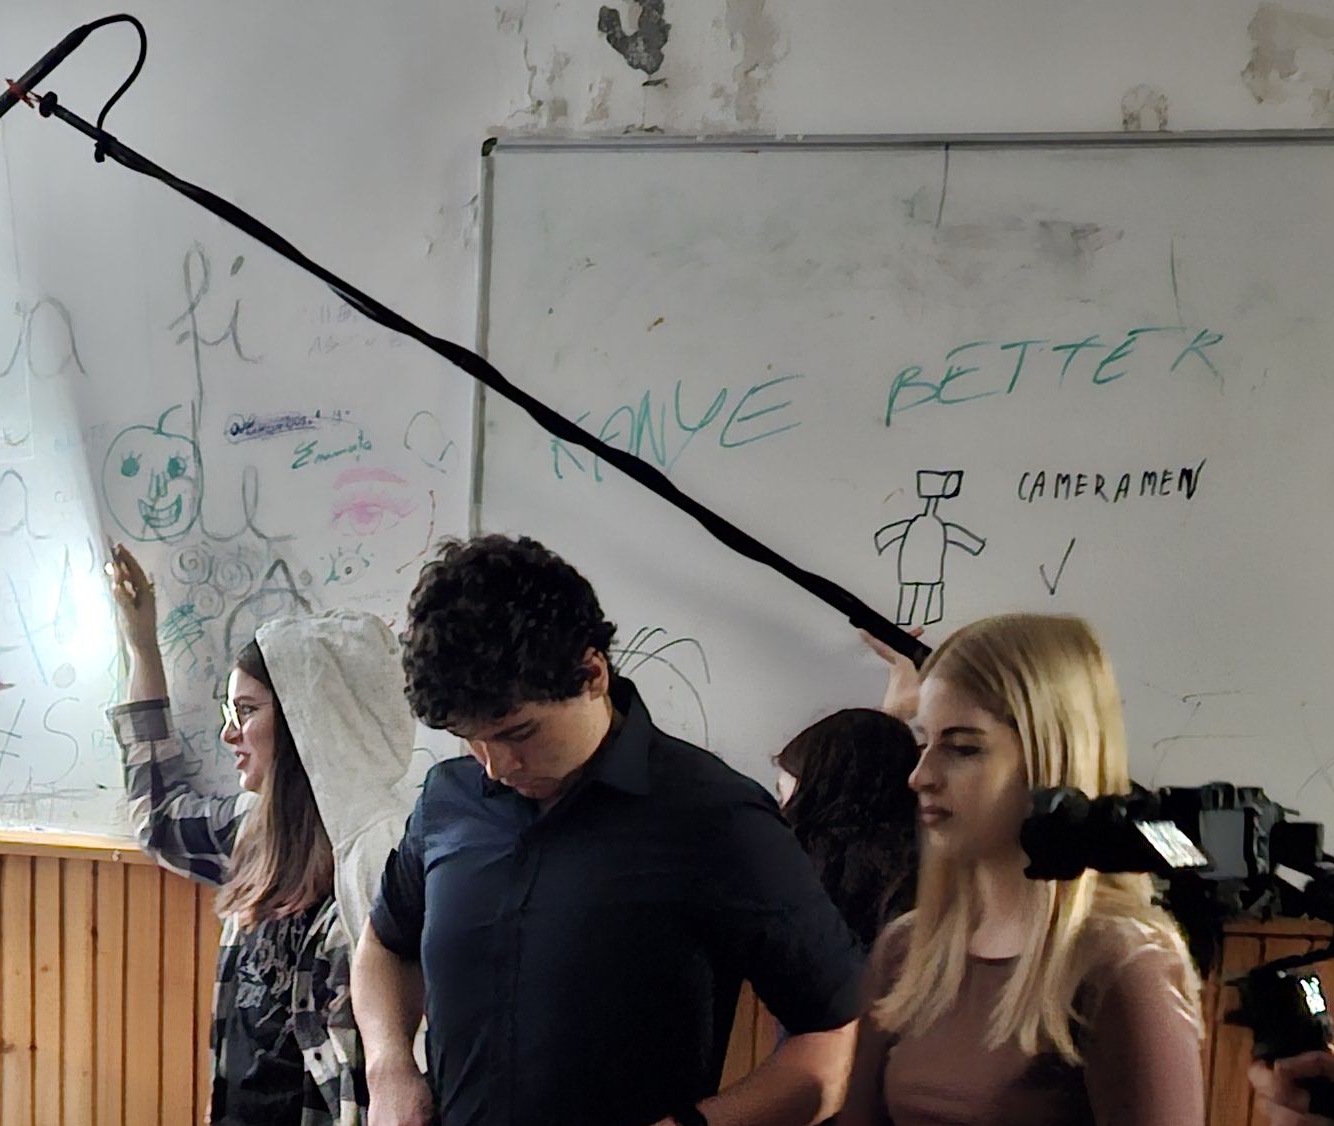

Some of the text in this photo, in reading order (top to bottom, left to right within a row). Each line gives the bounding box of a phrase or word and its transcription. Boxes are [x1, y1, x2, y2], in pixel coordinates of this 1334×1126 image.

[885, 326, 1227, 427] BETTER
[551, 373, 806, 483] KANYE
[1018, 458, 1208, 503] CAMERAMEN
